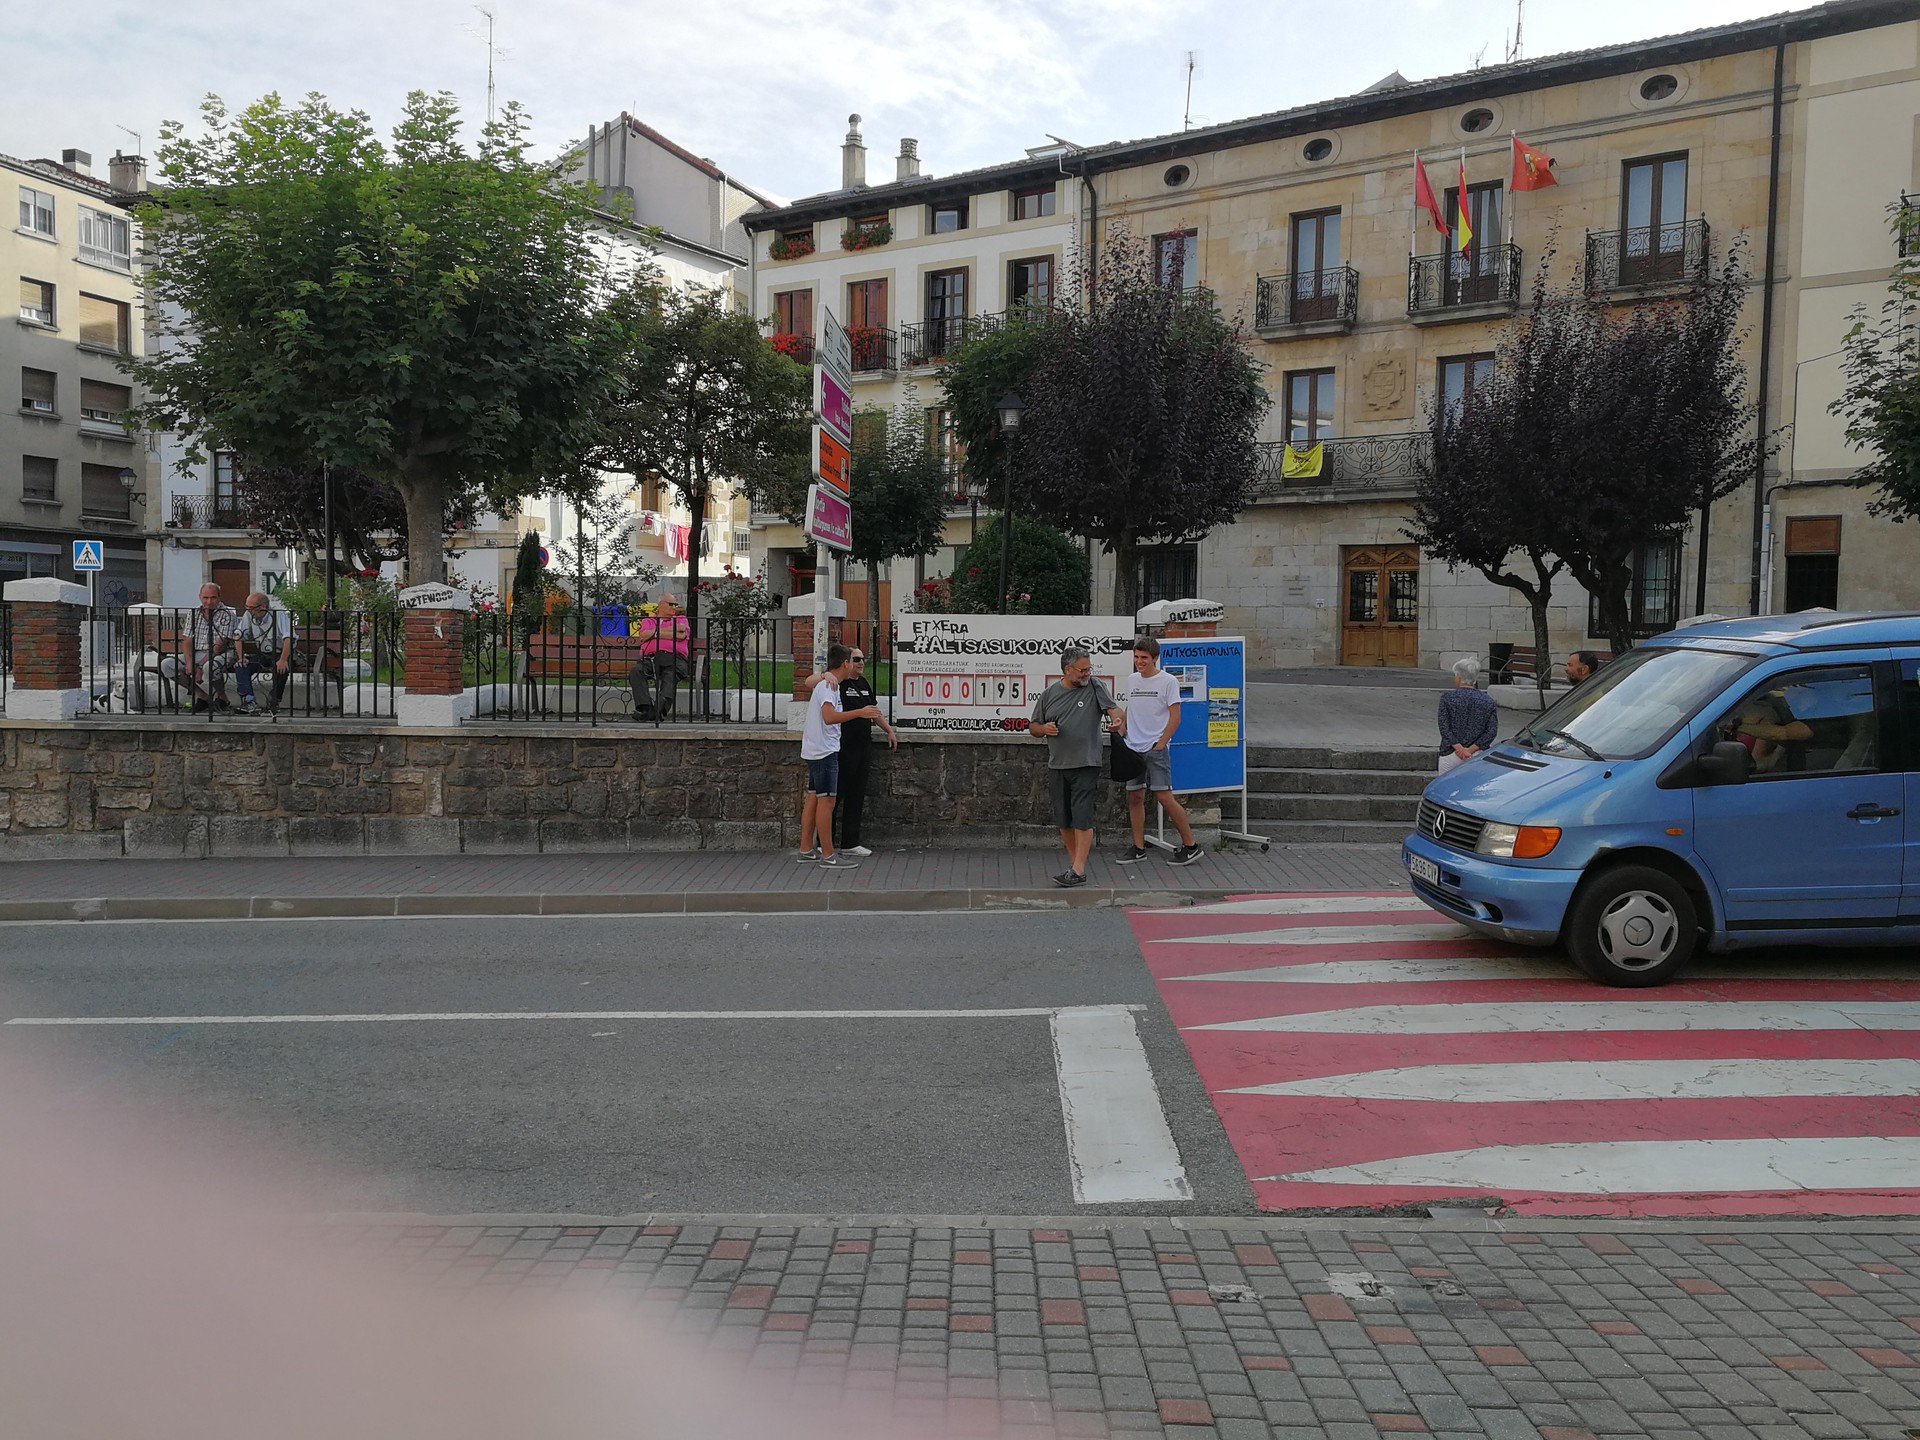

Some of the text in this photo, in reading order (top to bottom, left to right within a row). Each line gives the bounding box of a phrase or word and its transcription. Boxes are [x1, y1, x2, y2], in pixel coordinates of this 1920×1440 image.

[398, 589, 454, 609] GAZTEWOOD
[1169, 605, 1224, 622] GAZTEWOOD
[912, 620, 969, 634] ETXERA
[1162, 646, 1241, 658] INTXOSTIAPUNTA
[928, 707, 946, 716] egun
[990, 720, 1001, 730] EZ
[1003, 718, 1030, 730] STOP
